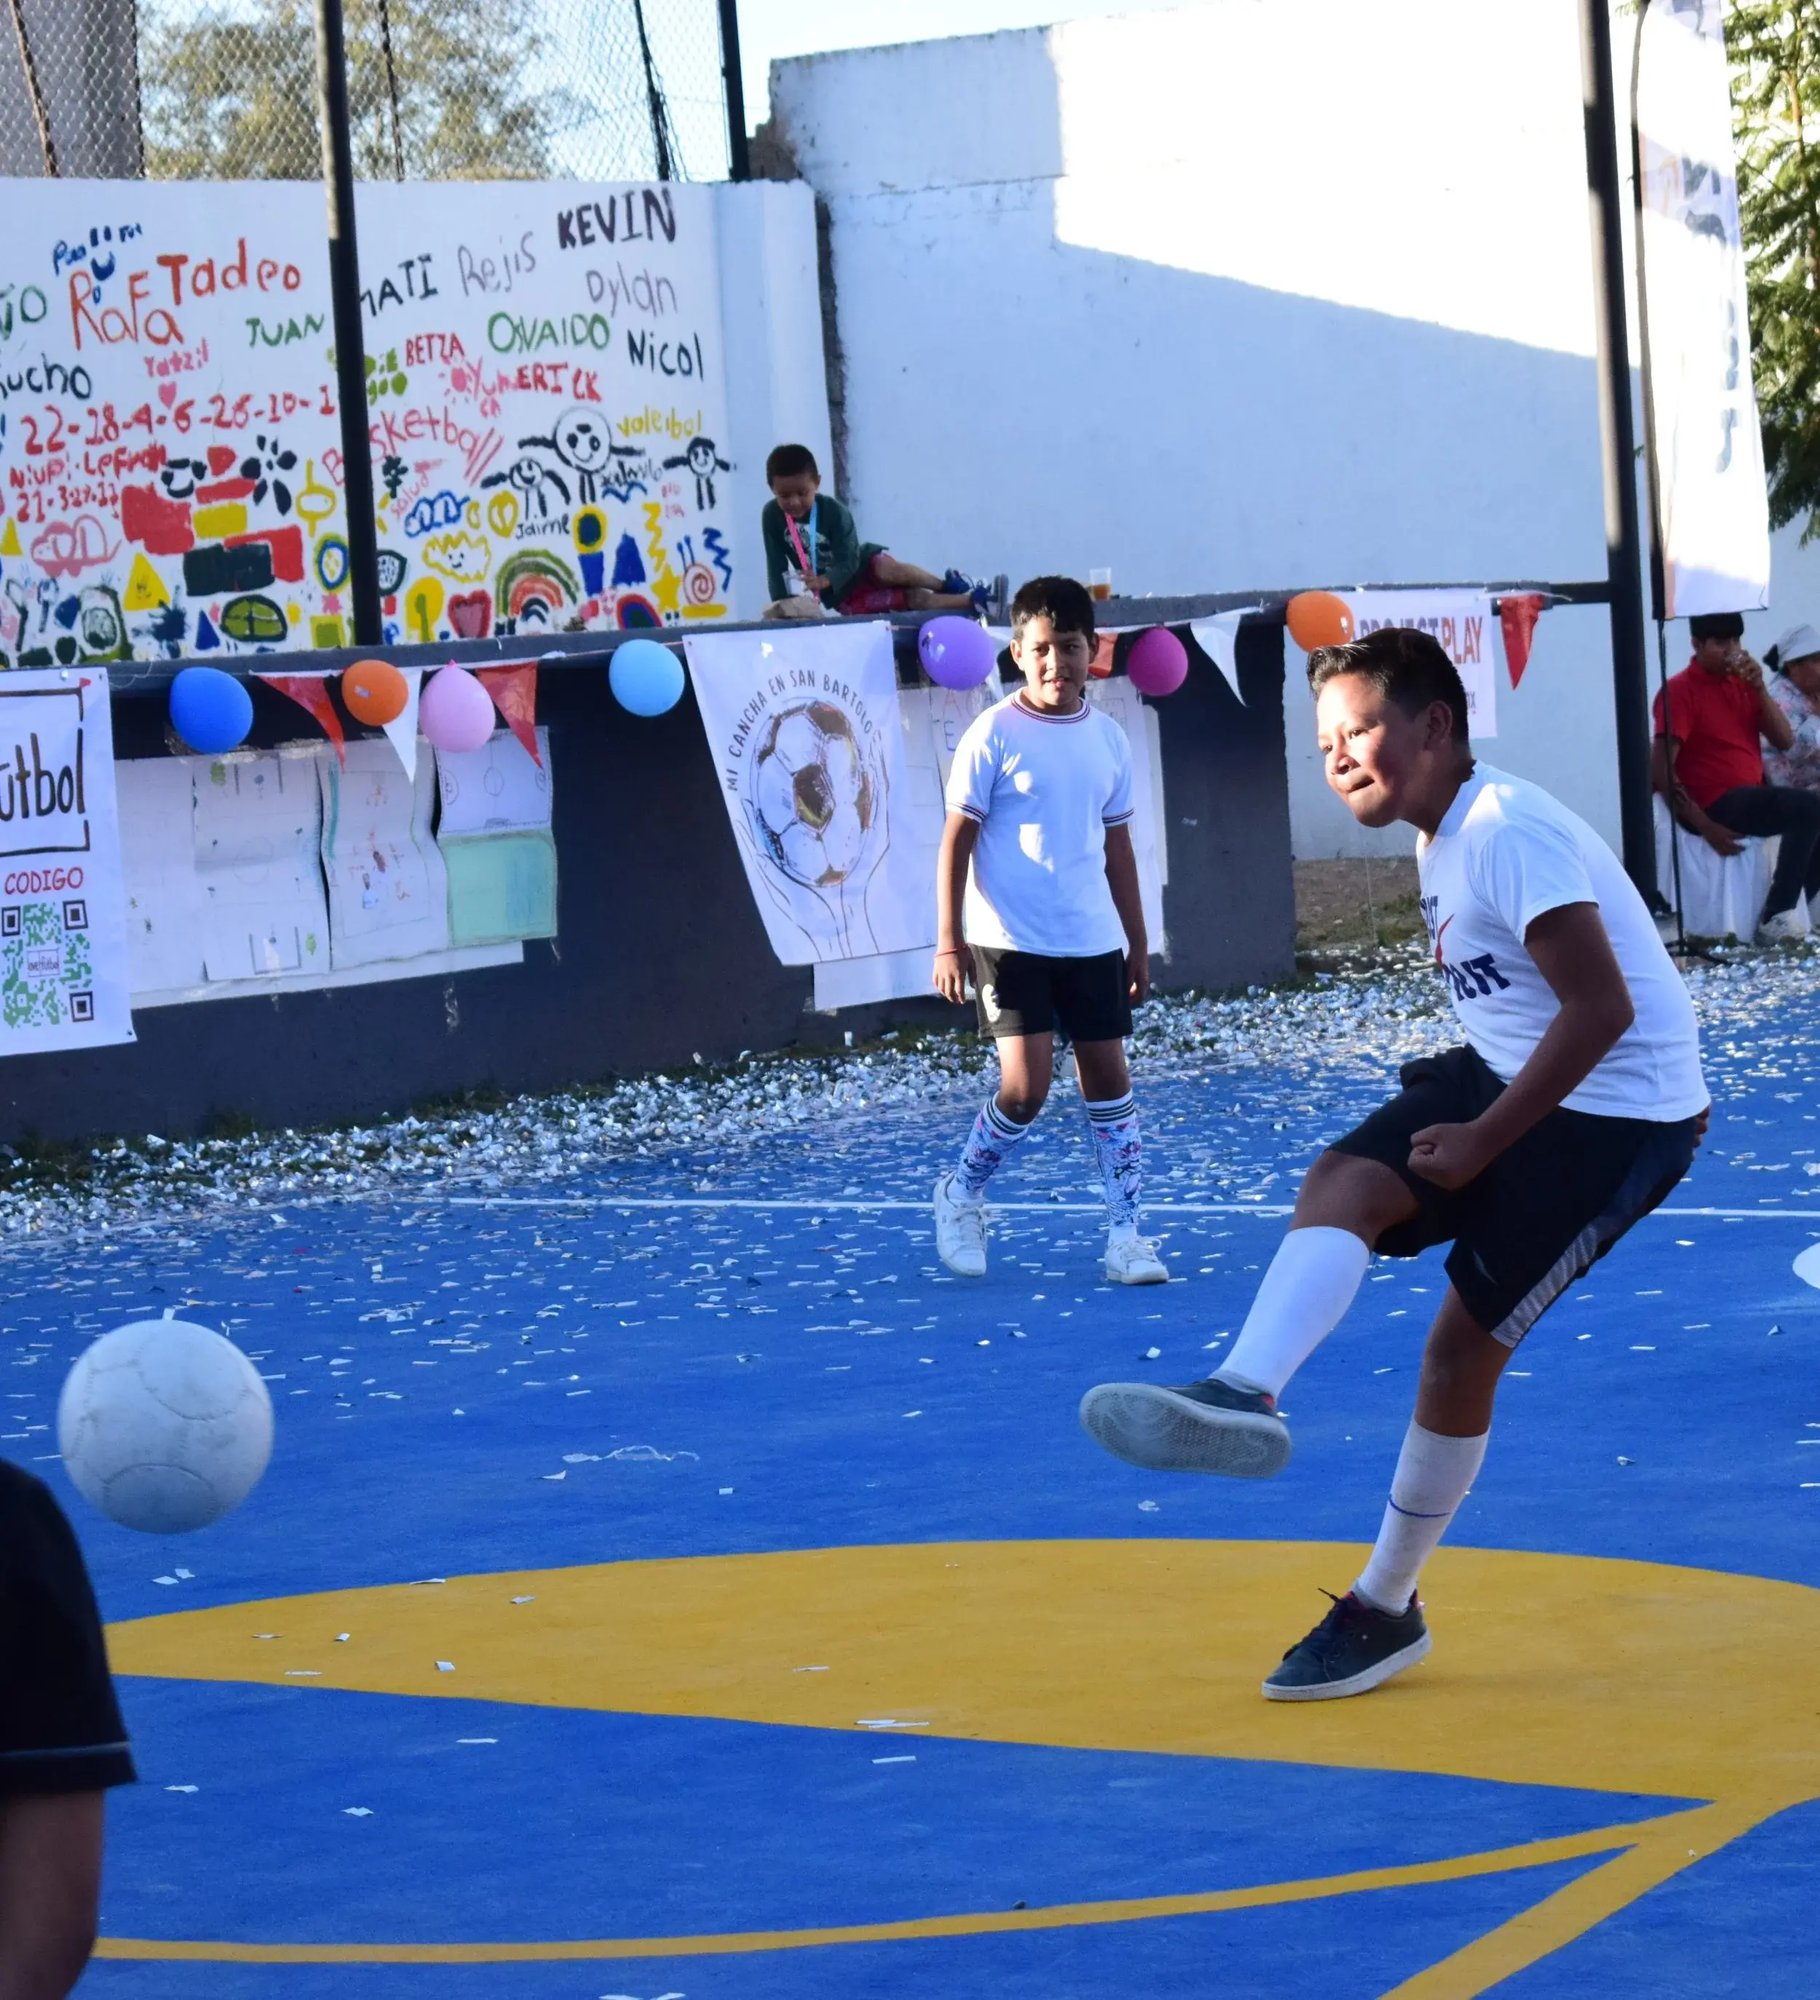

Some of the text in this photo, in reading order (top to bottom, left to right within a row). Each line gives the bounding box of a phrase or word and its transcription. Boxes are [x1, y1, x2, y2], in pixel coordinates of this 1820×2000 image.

[557, 187, 677, 250] KEVIN
[157, 237, 301, 306] Tadeo
[586, 260, 678, 319] Dylan
[245, 313, 325, 348] JUAN
[516, 361, 603, 402] ERICK
[322, 404, 504, 487] Bsketball
[726, 670, 873, 791] MI CANCHA EN SAN BARTOLO
[5, 866, 84, 895] CODIGO
